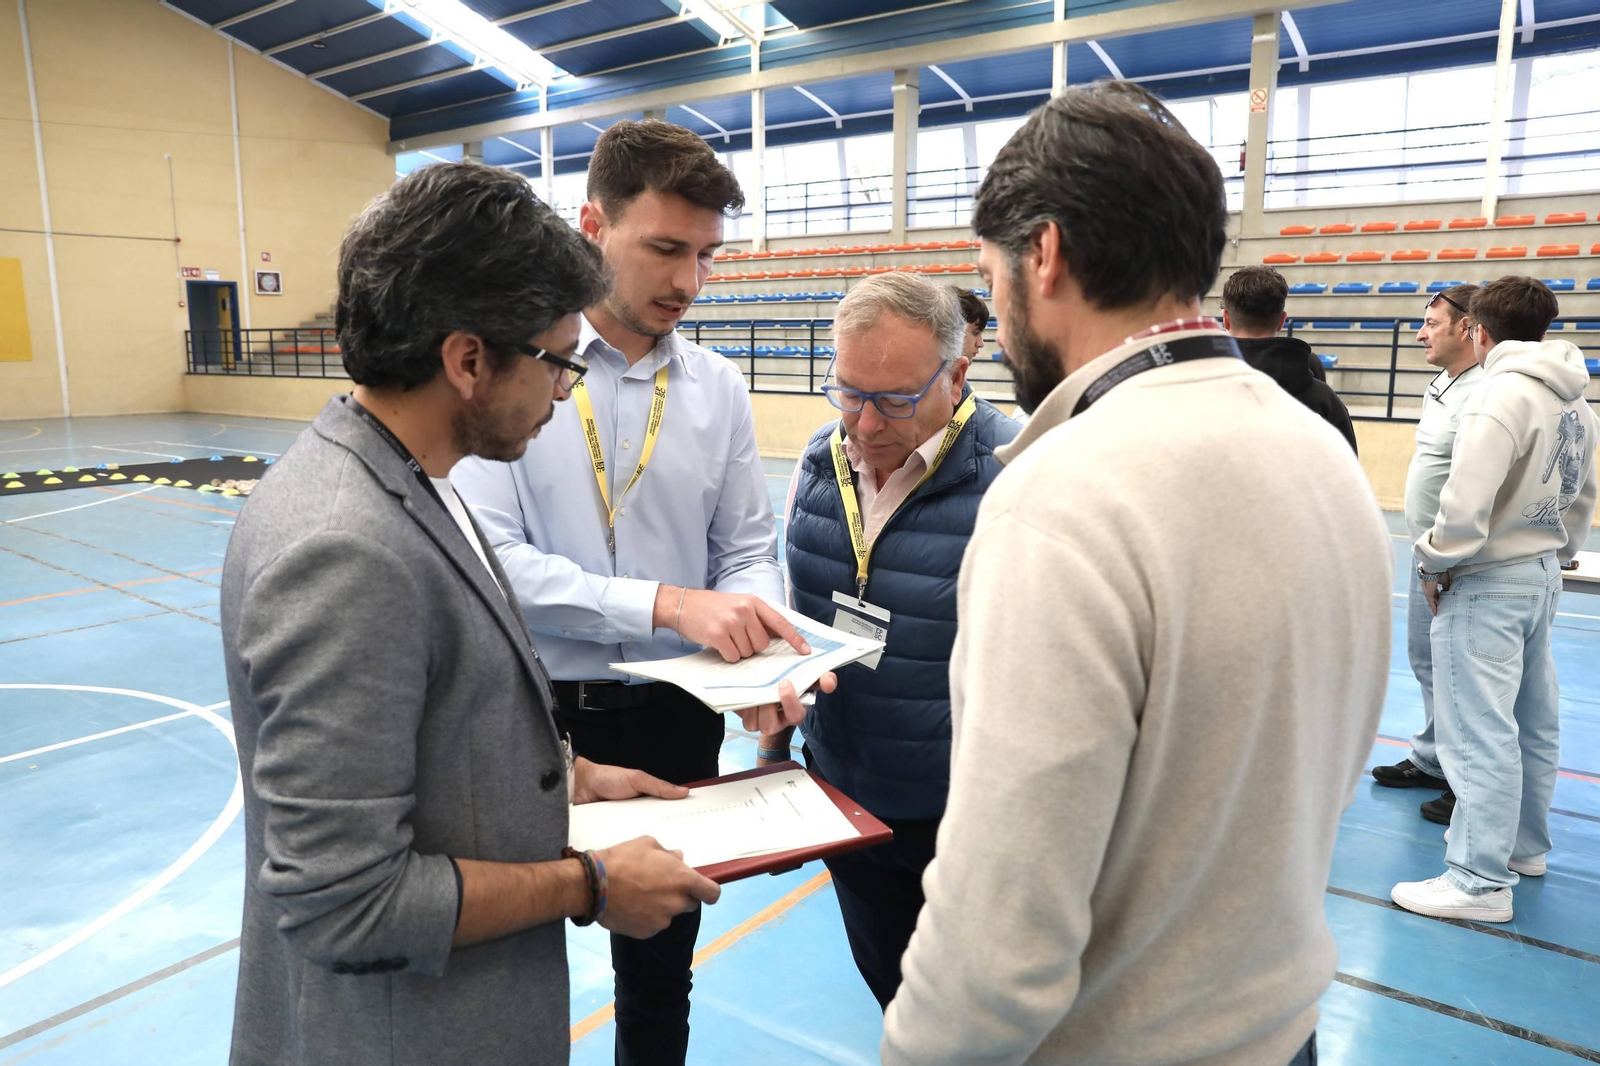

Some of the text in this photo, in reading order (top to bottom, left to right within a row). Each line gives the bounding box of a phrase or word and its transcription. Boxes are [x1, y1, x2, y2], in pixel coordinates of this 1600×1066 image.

[655, 386, 661, 395] EP
[660, 388, 666, 398] SC
[948, 419, 956, 428] EP
[954, 421, 962, 431] SC
[841, 478, 847, 487] SC
